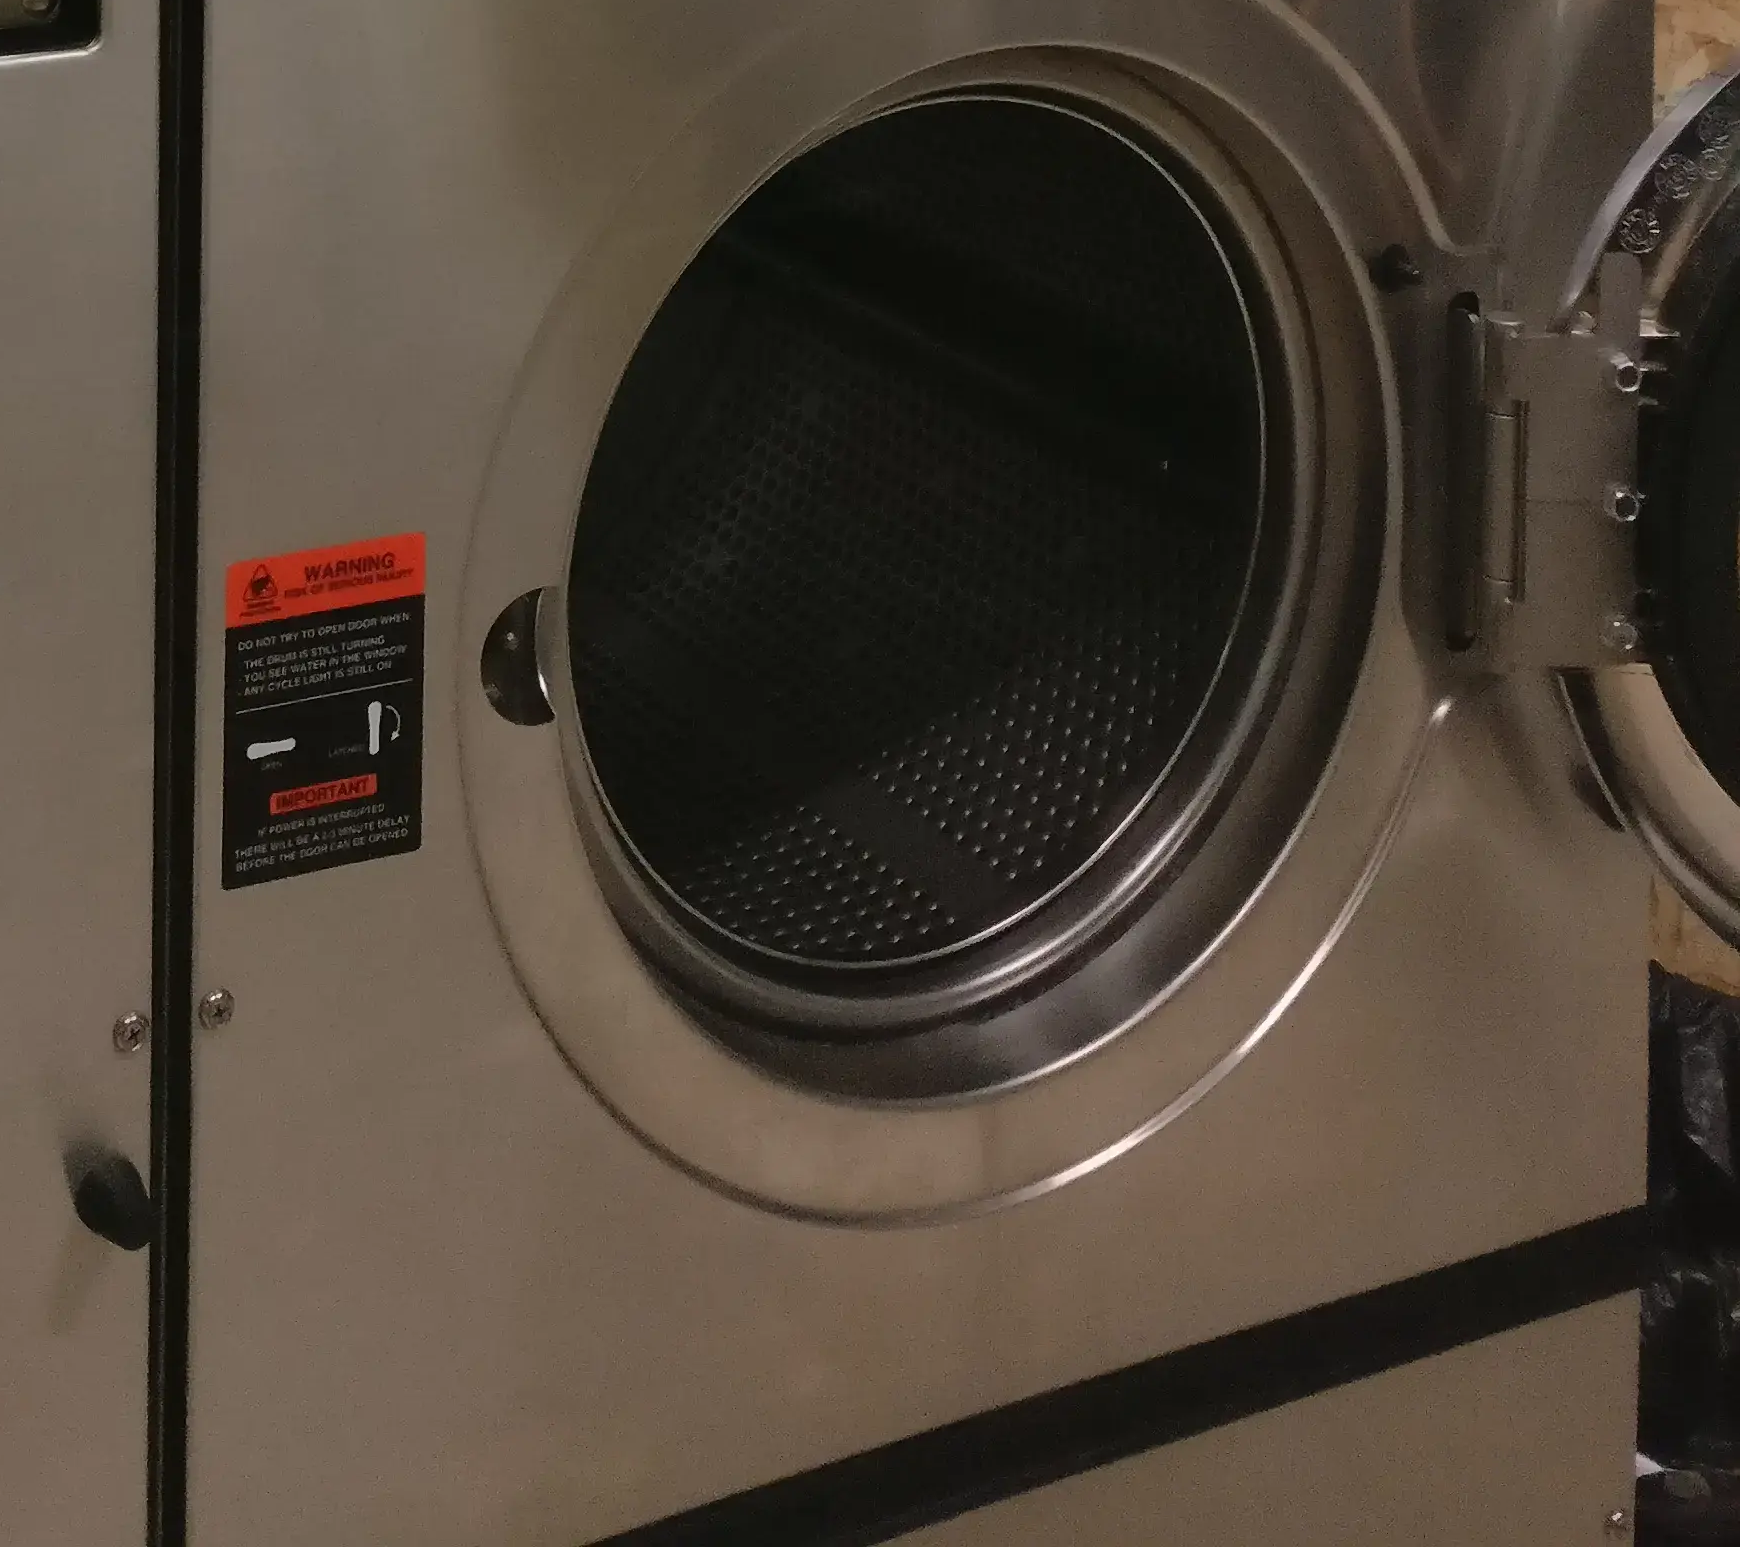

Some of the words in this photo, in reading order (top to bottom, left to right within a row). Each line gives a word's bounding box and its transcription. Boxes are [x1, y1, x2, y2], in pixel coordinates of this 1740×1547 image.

[304, 552, 396, 583] WARNING
[238, 639, 254, 652] DO
[256, 636, 277, 649] NOT
[280, 631, 299, 644] TRY
[302, 628, 316, 639] TO
[318, 622, 346, 637] OPEN
[347, 617, 377, 632] DOOR
[244, 657, 265, 670] THE
[299, 648, 308, 659] IS
[310, 643, 337, 657] STILL
[341, 635, 386, 651] TURNING
[244, 670, 266, 684] YOU
[268, 667, 288, 679] SEE
[290, 659, 327, 675] WATER
[341, 652, 362, 664] THE
[364, 643, 408, 661] WINDOW
[244, 684, 265, 697] ANY
[267, 677, 301, 692] CYCLE
[303, 672, 333, 686] LIGHT
[347, 664, 375, 676] STILL
[376, 660, 393, 672] ON
[275, 777, 369, 810] IMPORTANT
[234, 845, 268, 859] THERE
[296, 835, 310, 846] BE
[312, 832, 321, 842] A
[377, 813, 411, 829] DELAY
[268, 820, 305, 835] POWER
[235, 857, 276, 873] BEFORE
[299, 845, 329, 860] DOOR
[368, 827, 409, 843] OPENED
